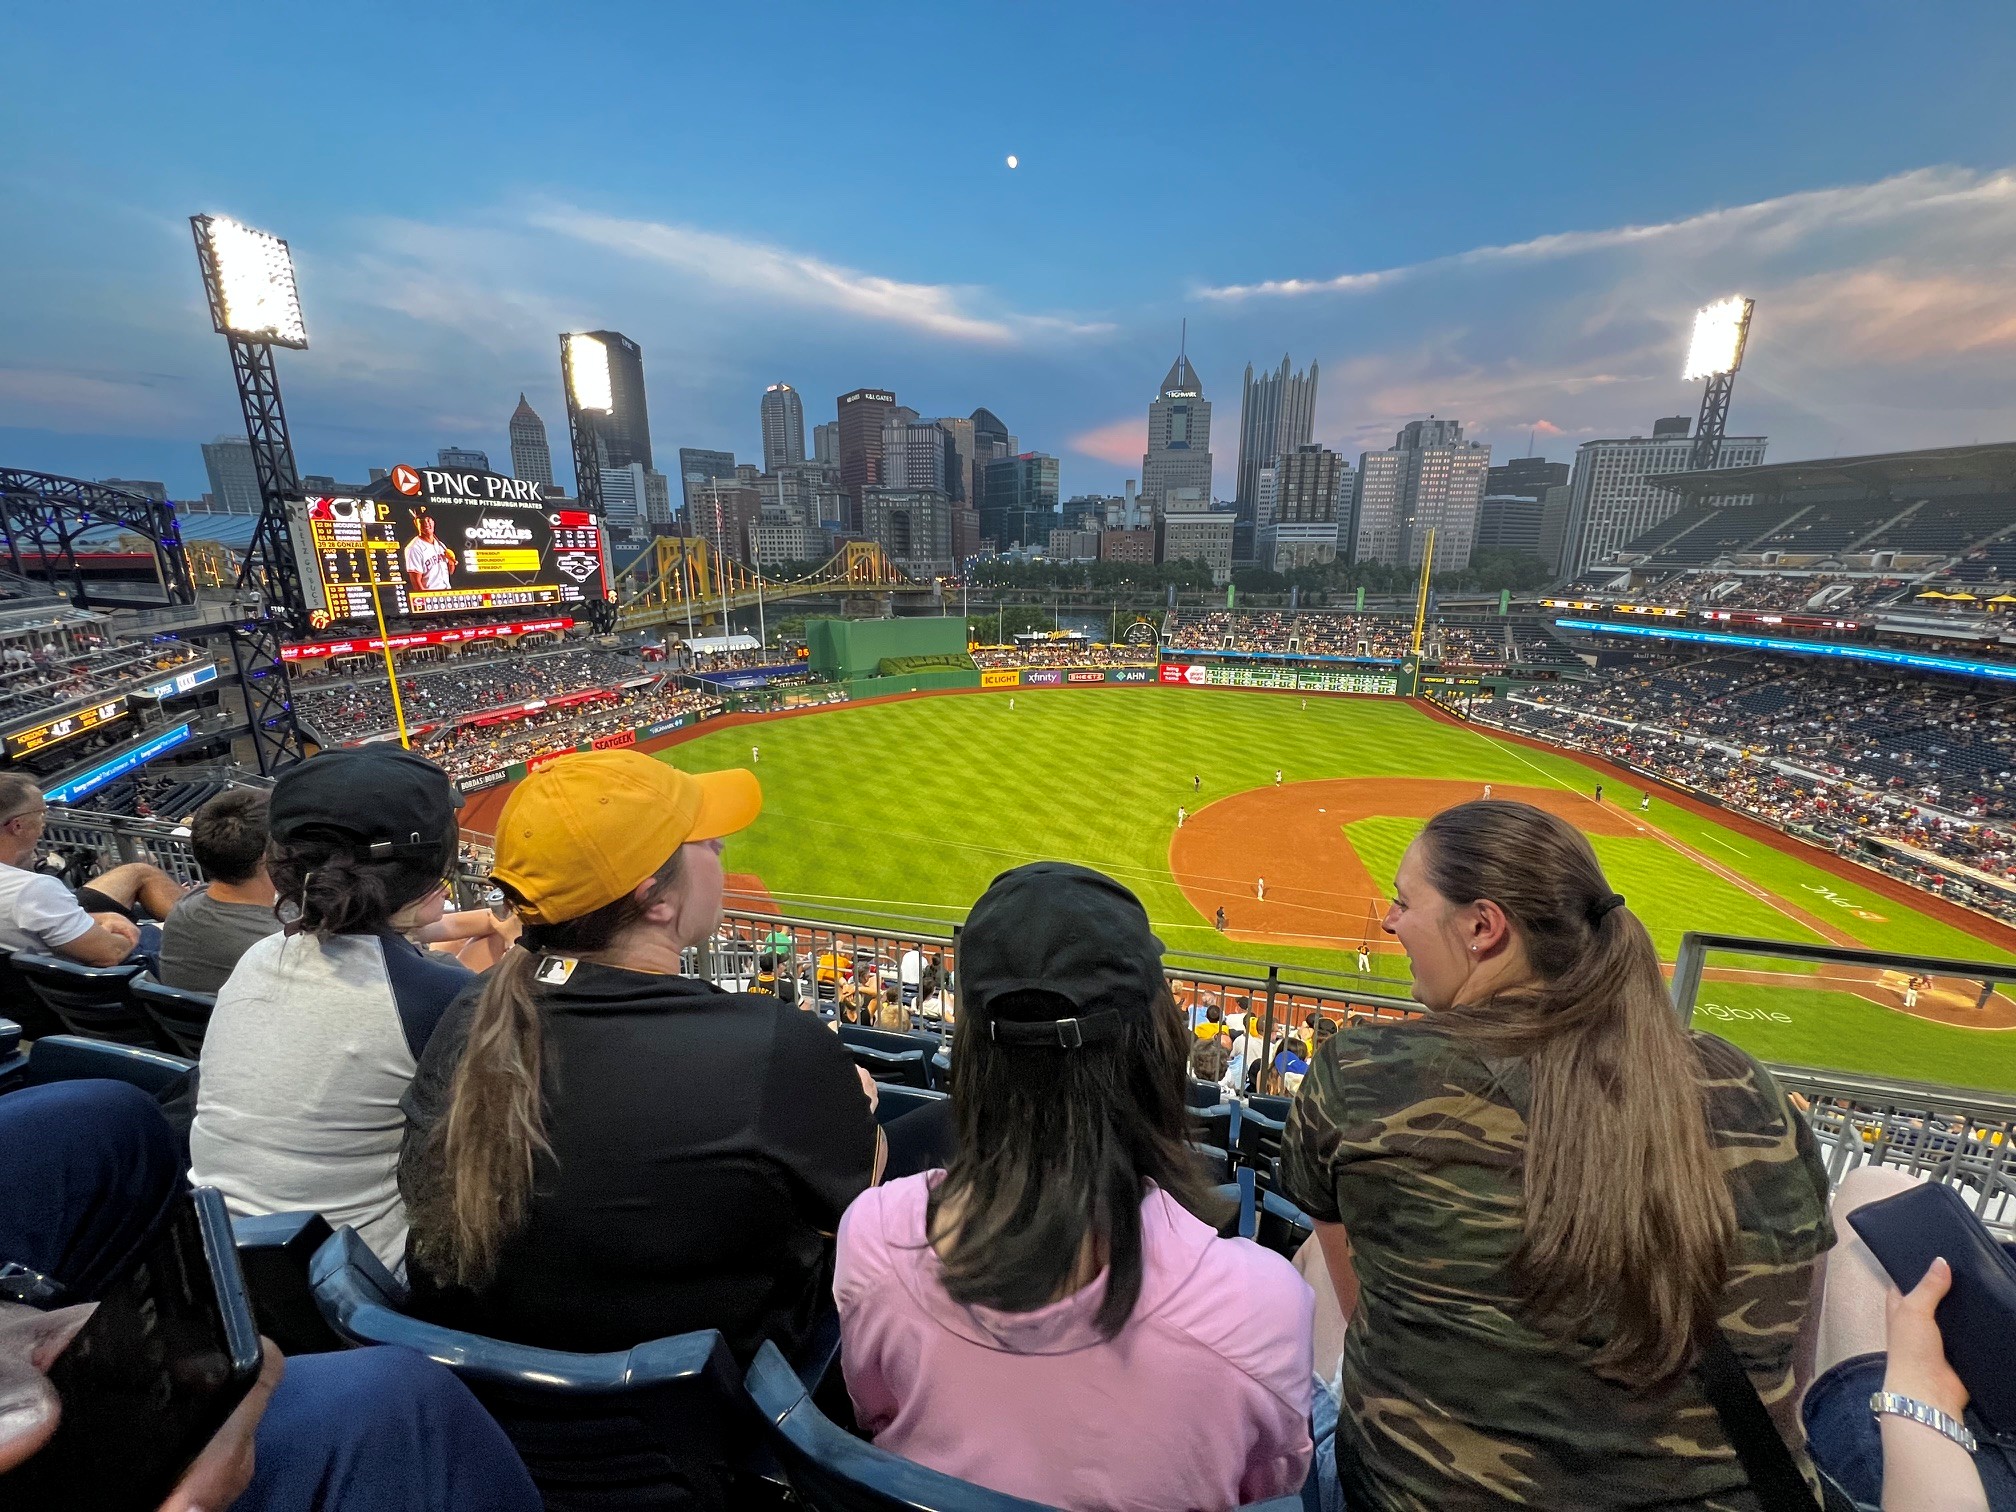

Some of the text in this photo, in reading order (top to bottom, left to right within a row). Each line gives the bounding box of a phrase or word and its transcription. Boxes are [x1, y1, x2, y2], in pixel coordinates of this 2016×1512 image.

[876, 394, 893, 402] GATES
[423, 470, 543, 501] PNC PARK
[430, 496, 452, 504] HOME
[464, 498, 478, 506] THE
[479, 500, 518, 508] PITTSBURGH
[519, 502, 543, 510] PIRATES
[377, 503, 390, 520] P
[482, 518, 516, 529] NICK
[465, 527, 533, 540] GONZALES
[995, 675, 1017, 684] LIGHT
[1028, 672, 1057, 684] xfinity
[1126, 672, 1145, 680] AHN
[594, 732, 632, 750] SEATGEEK
[461, 777, 483, 790] BORDAS
[485, 770, 506, 783] BORDAS
